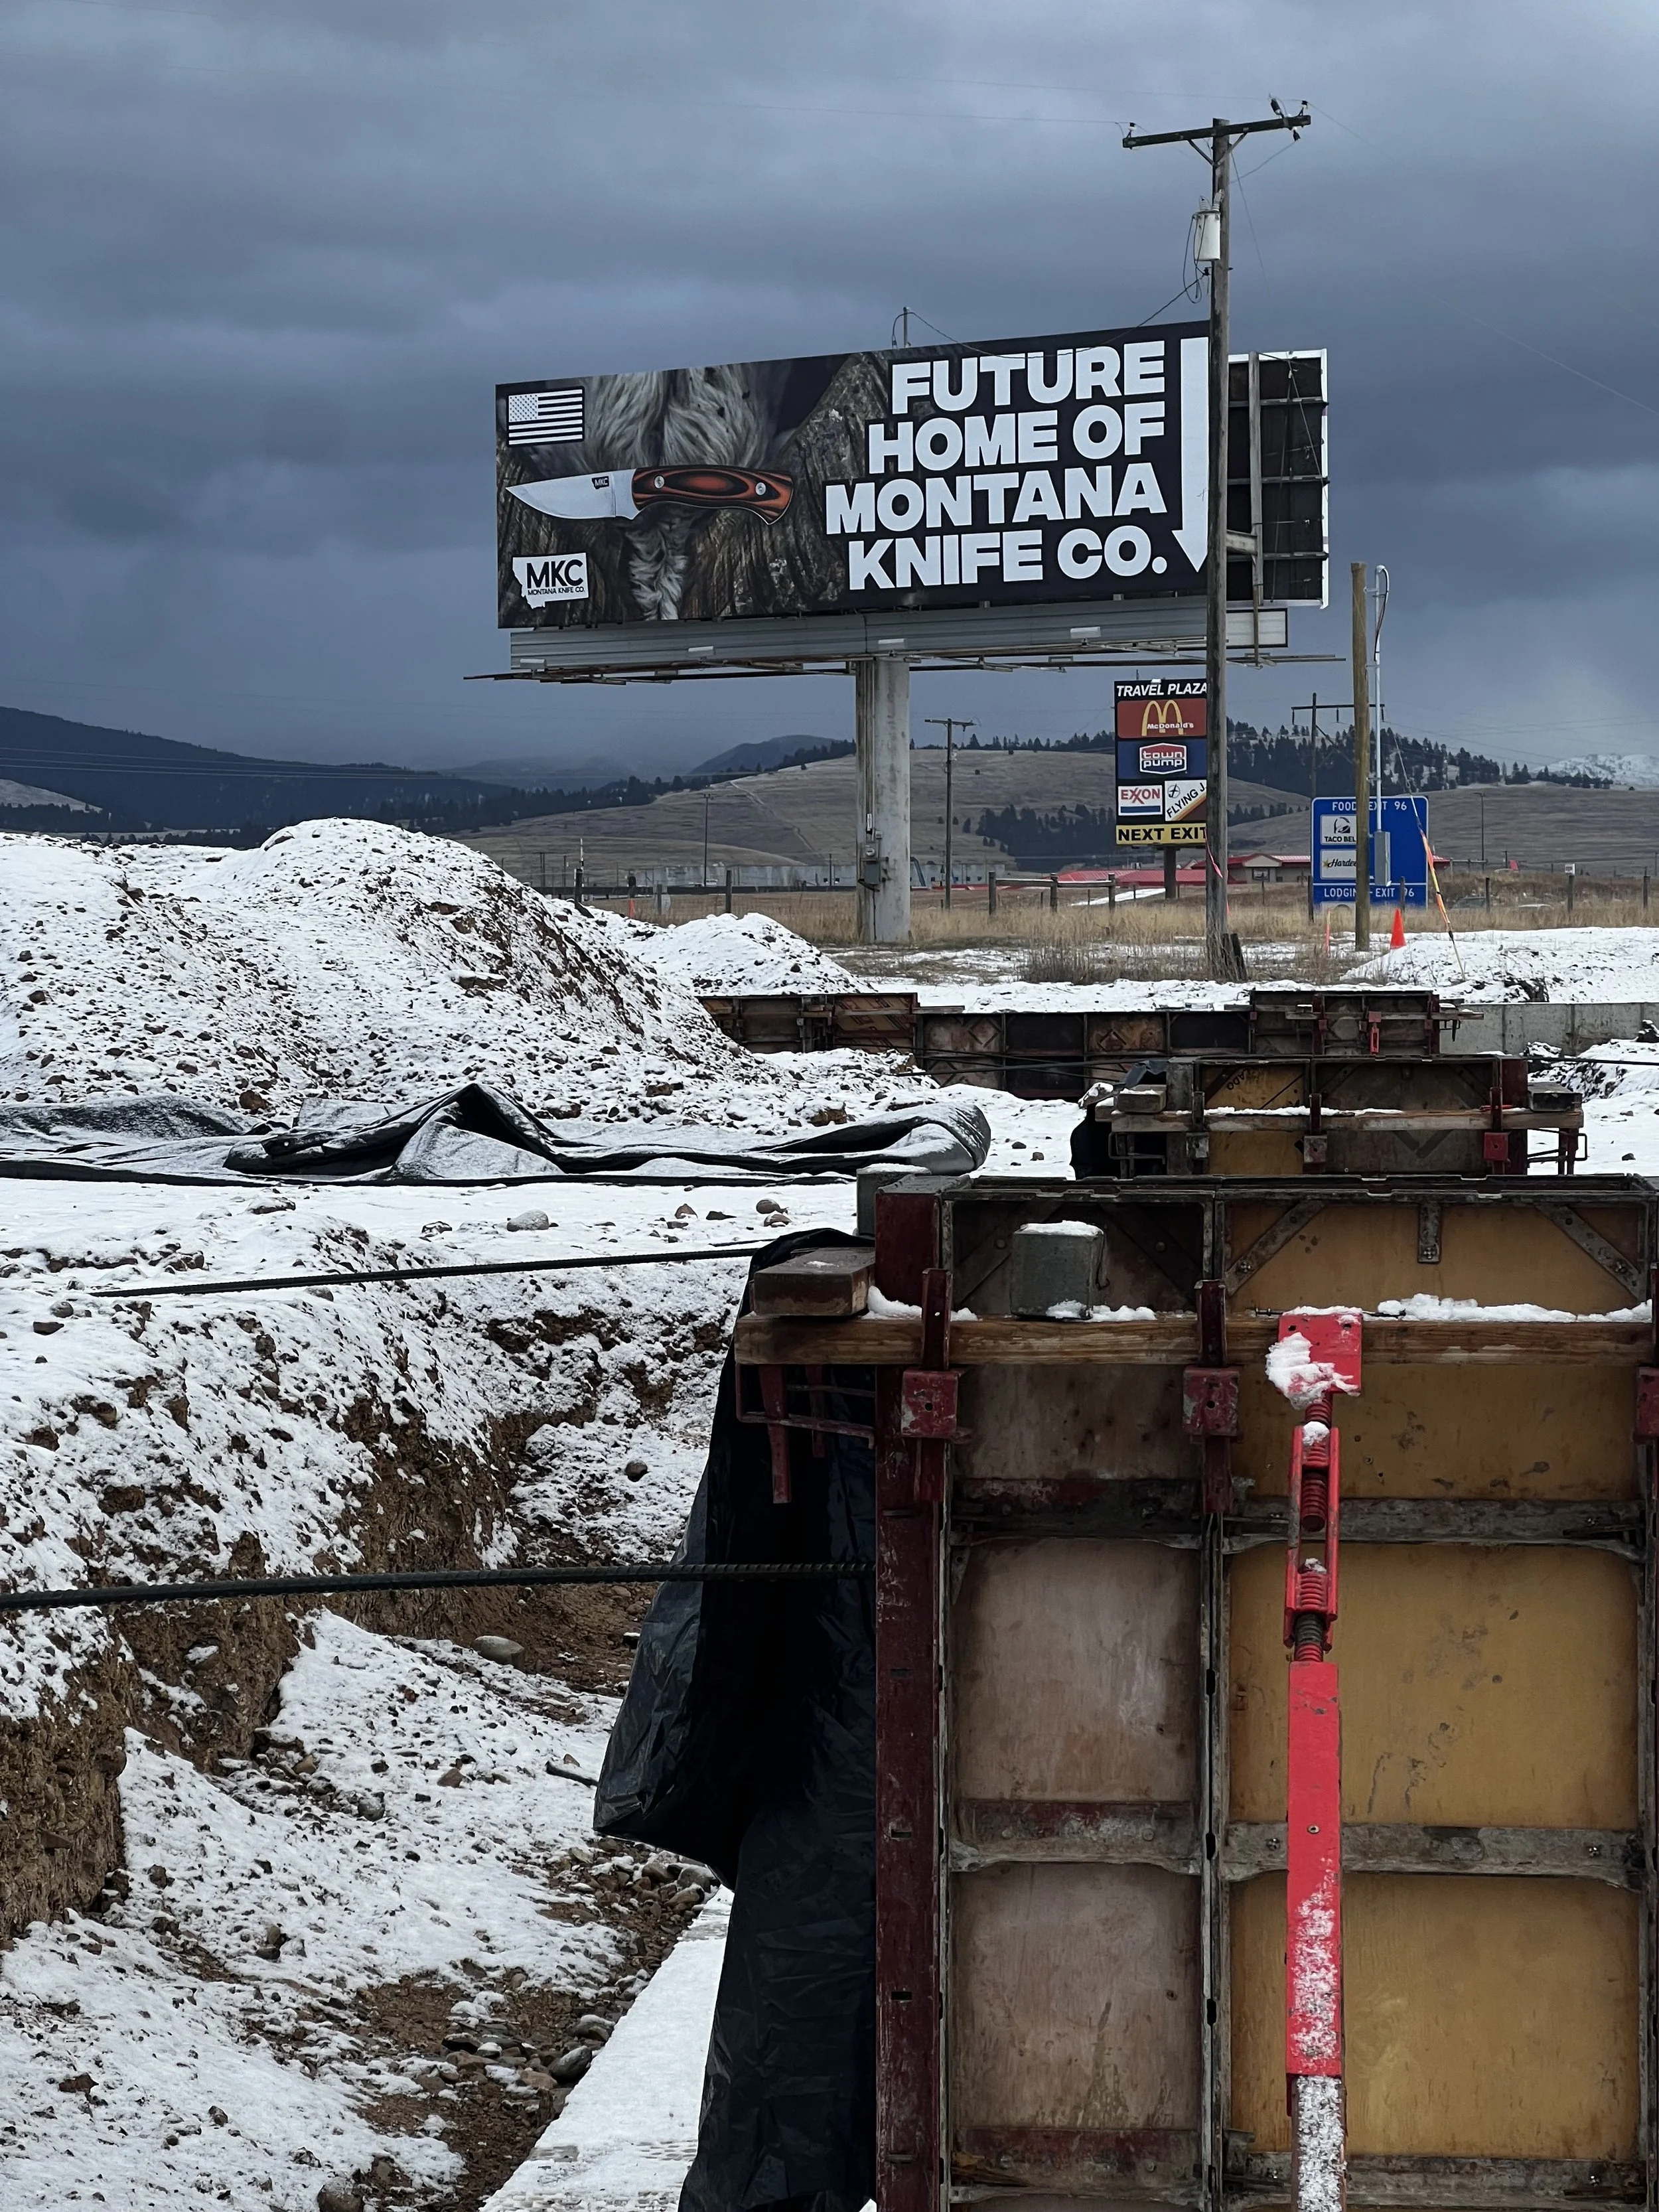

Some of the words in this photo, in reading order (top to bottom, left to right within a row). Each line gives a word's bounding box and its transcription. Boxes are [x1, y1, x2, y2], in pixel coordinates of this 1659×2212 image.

[892, 340, 1165, 415] FUTURE
[869, 409, 1059, 475] HOME
[1072, 401, 1166, 460] OF
[826, 462, 1168, 535] MONTANA
[849, 529, 1044, 591] KNIFE
[1057, 525, 1167, 580] CO.
[526, 559, 584, 589] MKC
[1116, 684, 1165, 697] TRAVEL
[1167, 682, 1207, 696] PLAZA
[1143, 759, 1183, 769] pump
[1121, 787, 1161, 805] EXXON
[1166, 789, 1198, 818] FLYING
[1200, 782, 1206, 792] J
[1394, 800, 1407, 811] 96
[1118, 828, 1165, 842] NEXT
[1375, 887, 1396, 897] EXIT
